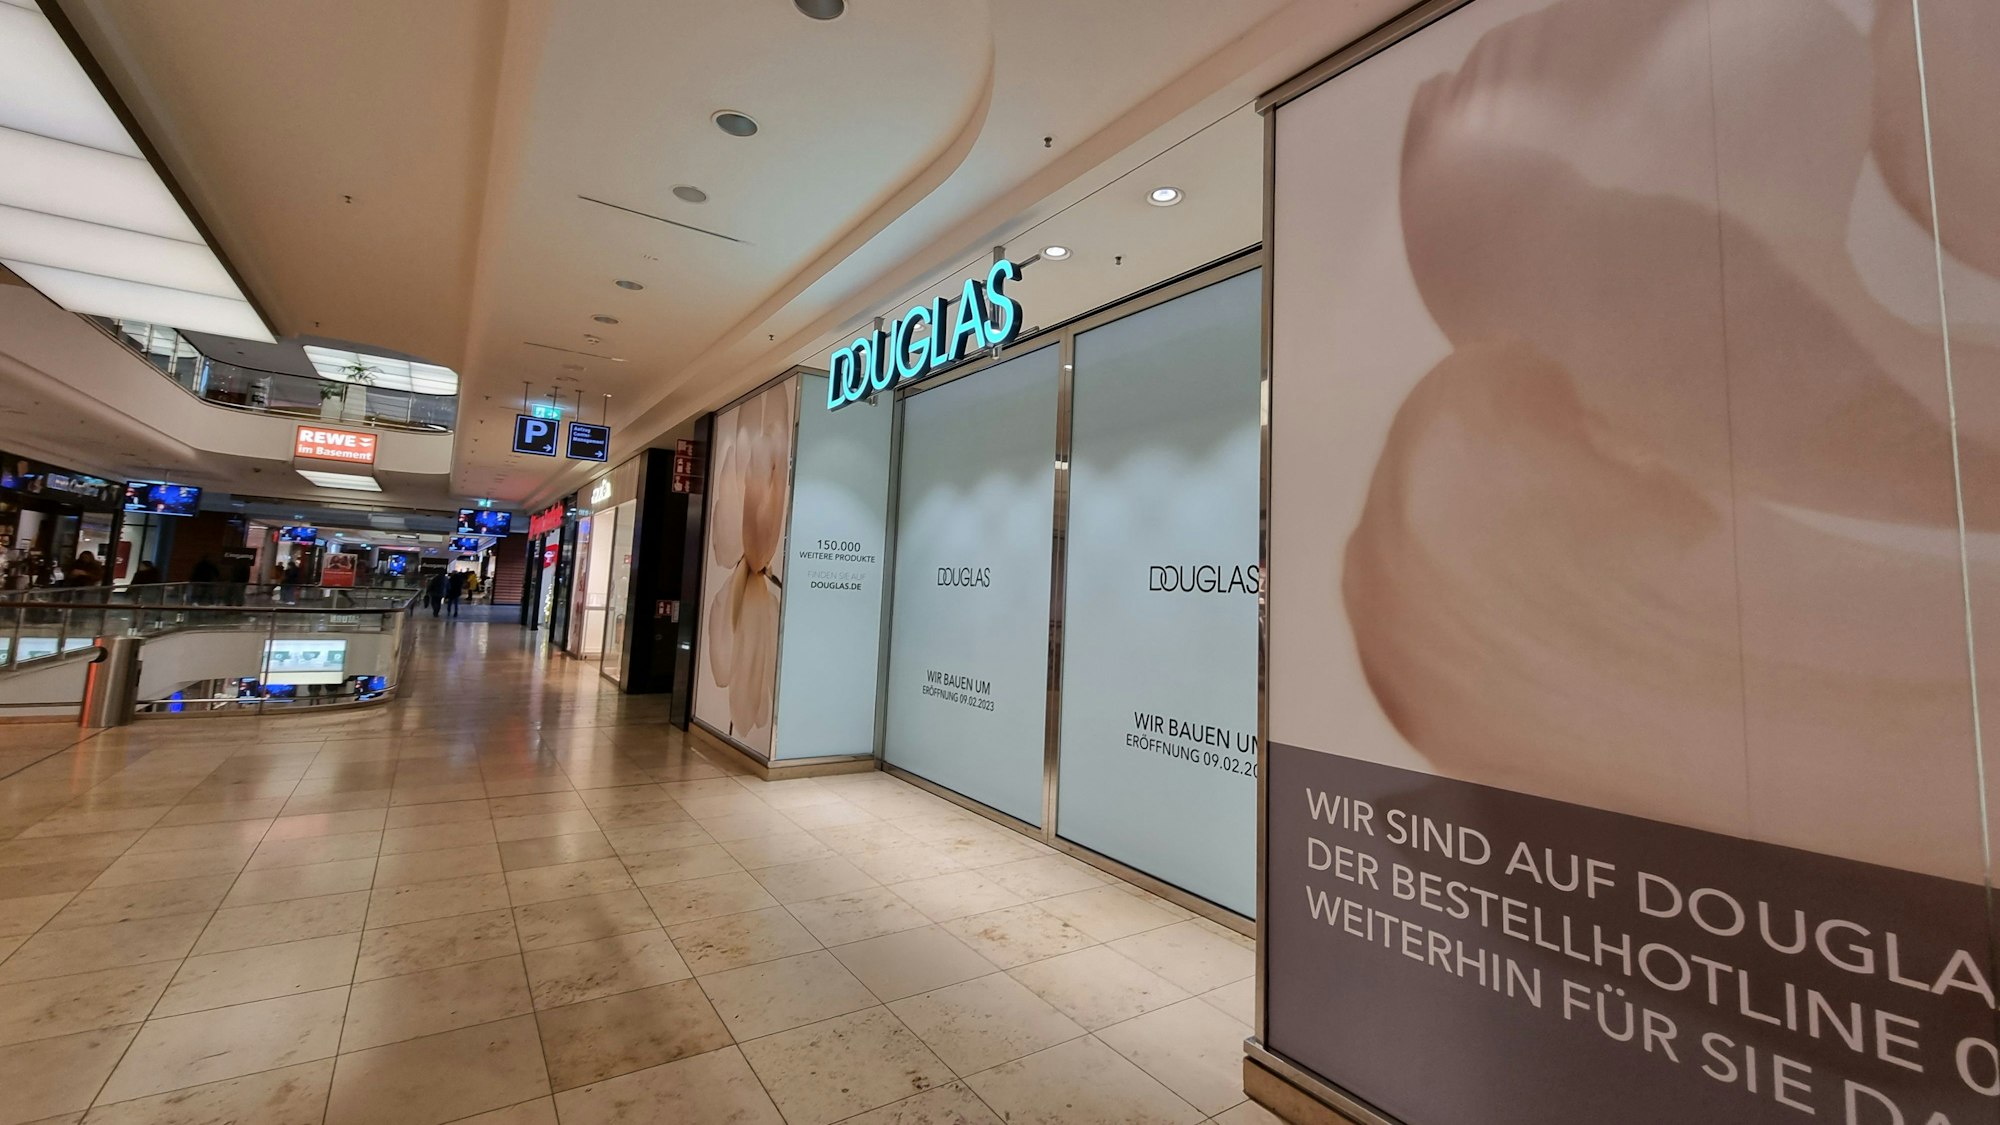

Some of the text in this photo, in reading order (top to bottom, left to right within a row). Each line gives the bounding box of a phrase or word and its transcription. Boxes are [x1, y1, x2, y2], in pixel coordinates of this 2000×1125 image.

[827, 259, 1022, 411] DOUGLAS
[300, 429, 357, 447] REWE
[525, 420, 548, 444] P
[298, 444, 372, 460] im Basement
[799, 551, 876, 563] WEITERE PRODUKTE
[817, 540, 861, 552] 150.000
[810, 581, 862, 590] DOUGLAS.DE
[937, 567, 991, 588] DOUGLAS
[1149, 565, 1259, 594] DOUGLAS
[927, 669, 991, 695] WIR BAUEN UM
[922, 685, 995, 712] ERÖFFNUNG 09.02.2023
[1134, 711, 1164, 734] WIR
[1168, 718, 1230, 749] BAUEN
[1126, 734, 1200, 763] ERÖFFNUNG
[1306, 787, 1996, 1009] WIR SIND AUF DOUGLA
[1307, 837, 1379, 891] DER
[1392, 863, 1924, 1073] BESTELLHOTLINE
[1305, 885, 1951, 1125] WEITERHIN FÜR SIE D
